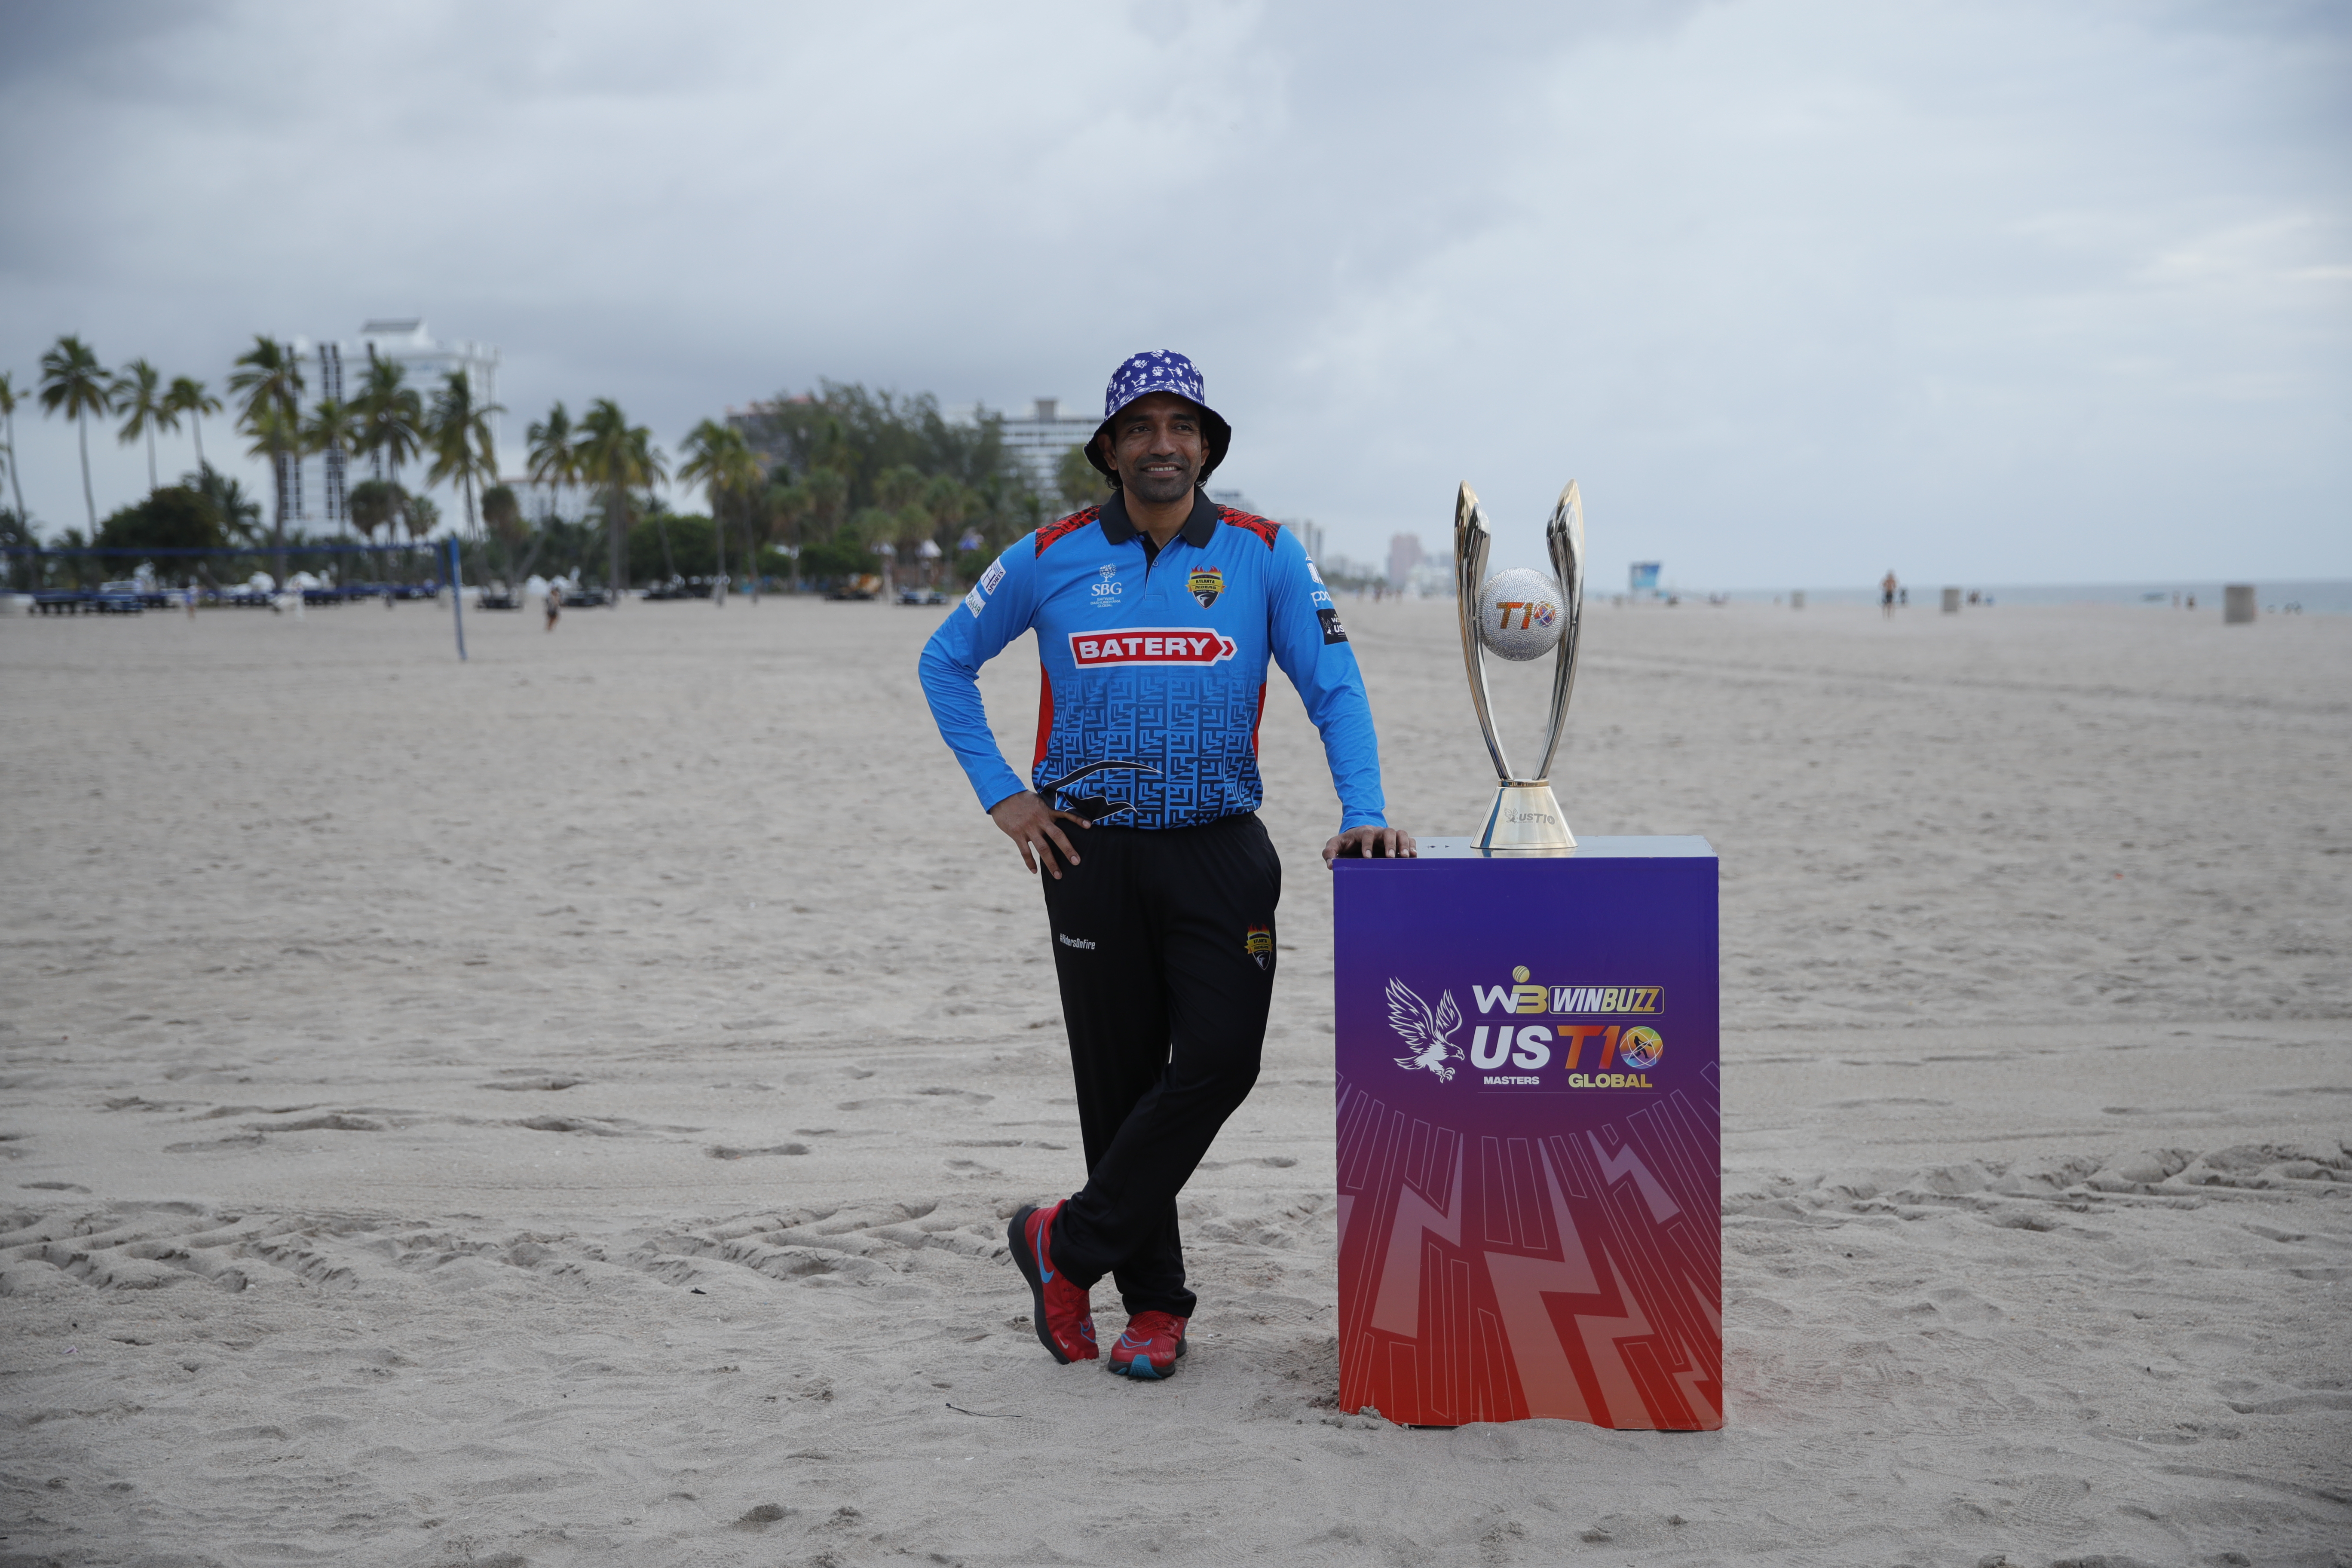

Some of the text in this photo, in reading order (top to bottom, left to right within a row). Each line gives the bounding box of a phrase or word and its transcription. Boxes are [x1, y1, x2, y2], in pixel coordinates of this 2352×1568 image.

[988, 570, 1004, 593] SPORTS
[1091, 582, 1122, 596] SBG
[968, 592, 981, 614] DOLLAR
[1497, 601, 1556, 629] T10
[1334, 625, 1344, 633] US
[1079, 637, 1210, 658] BATERY
[1060, 933, 1096, 949] #RidersOnFire
[1553, 988, 1659, 1012] WINBUZZ
[1484, 1076, 1540, 1085] MASTERS
[1568, 1073, 1653, 1088] GLOBAL
